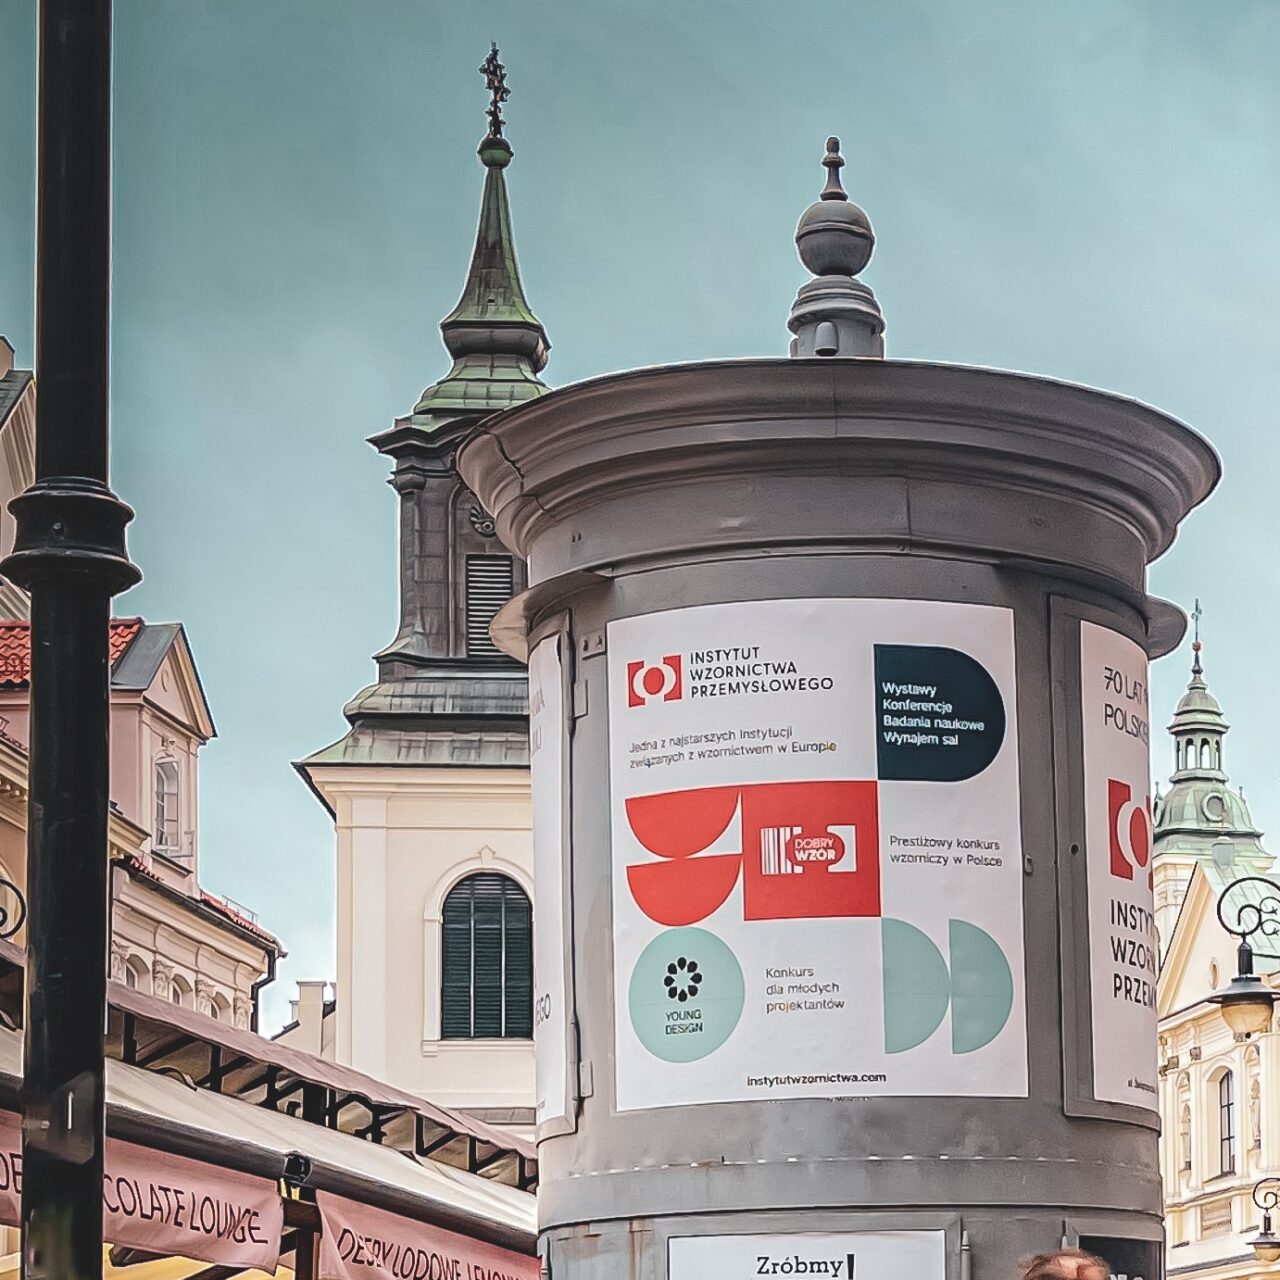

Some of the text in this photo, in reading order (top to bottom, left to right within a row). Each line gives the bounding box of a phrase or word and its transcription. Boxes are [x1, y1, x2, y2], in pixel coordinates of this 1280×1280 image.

[690, 647, 760, 665] INSTYTUT
[690, 661, 797, 681] WZORNICTWA
[691, 677, 834, 698] PRZEMYSŁOWEGO
[1104, 666, 1123, 695] 70
[882, 682, 937, 698] Wystawy
[883, 715, 985, 731] Badania naukowe
[660, 738, 666, 749] z
[669, 730, 736, 751] najstarszych
[883, 731, 959, 747] Wynajem sal
[688, 750, 695, 761] z
[697, 745, 775, 760] wzornictwem
[777, 743, 788, 753] w
[791, 741, 837, 754] Europie
[794, 837, 834, 850] DOBRY
[956, 837, 1001, 851] konkurs
[890, 853, 1003, 867] wzorniczy w Polsce
[765, 966, 815, 979] Konkurs
[766, 982, 840, 996] dla młodych
[766, 999, 845, 1014] projektantów
[665, 1008, 702, 1022] YOUNG
[665, 1022, 703, 1035] DESIGN
[747, 1072, 887, 1088] instytutwzornictwa.com
[103, 1174, 269, 1244] COLATE LOUNGE
